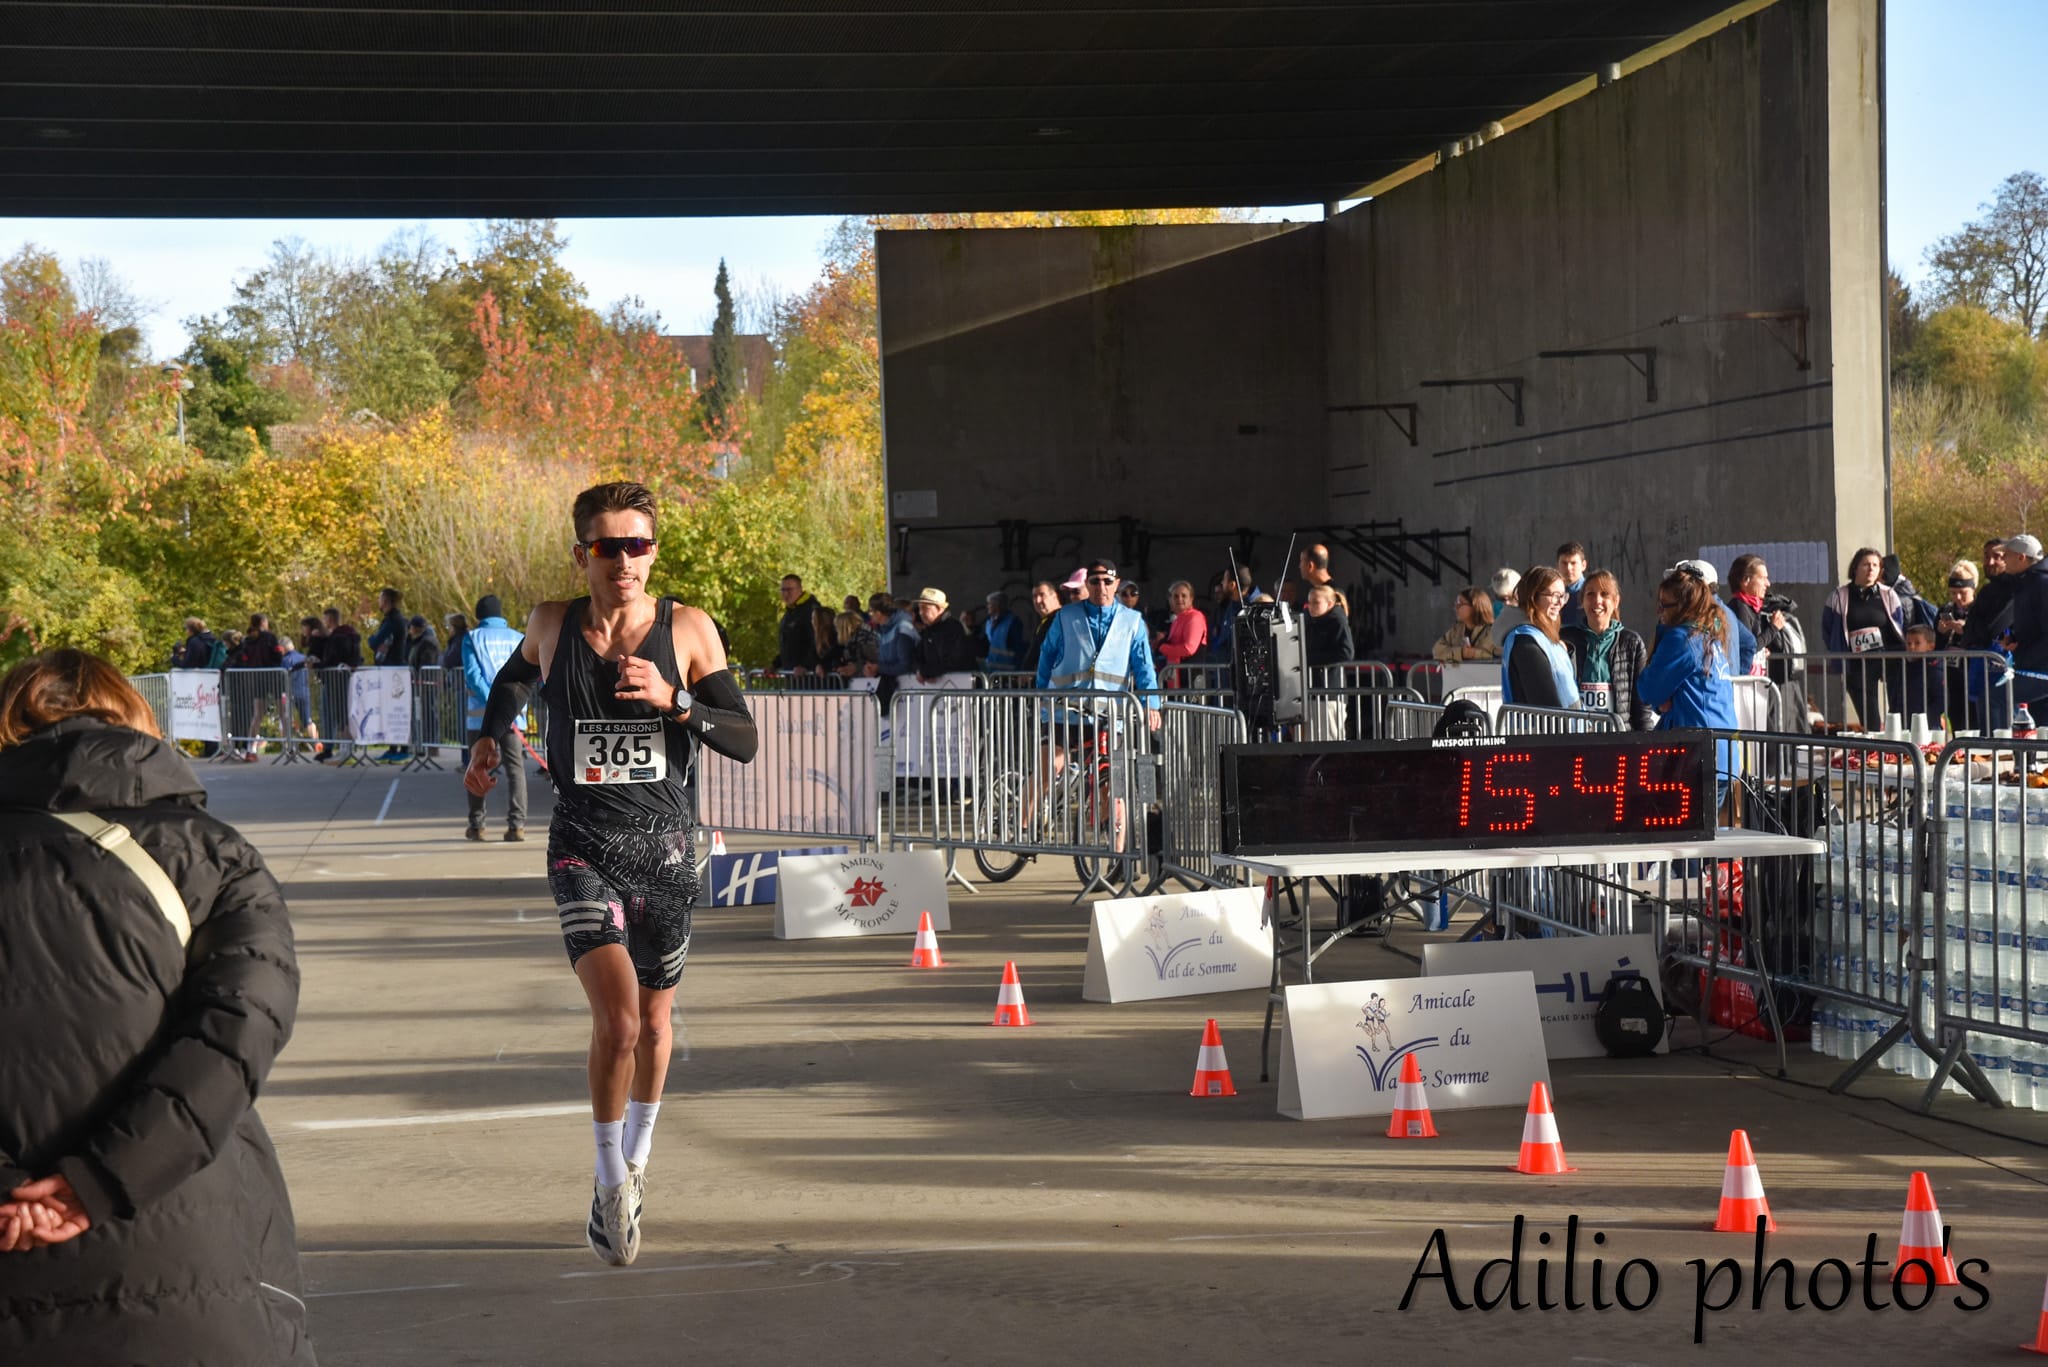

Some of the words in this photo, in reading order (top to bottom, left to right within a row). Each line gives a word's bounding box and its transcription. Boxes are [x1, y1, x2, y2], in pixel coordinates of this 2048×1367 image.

[1855, 632, 1876, 647] 641
[583, 724, 602, 733] LES
[604, 724, 611, 732] 4
[613, 722, 659, 733] SAISONS
[1431, 738, 1474, 748] MATSPORT
[1474, 736, 1506, 746] TIMING
[588, 735, 652, 766] 365
[840, 856, 885, 873] AMIENS
[834, 899, 900, 929] MÉTROPOLE
[1208, 930, 1224, 945] du
[1182, 964, 1195, 977] de
[1197, 961, 1237, 977] Somme
[1407, 988, 1476, 1014] Amicale
[1541, 1014, 1570, 1025] NÇAISE
[1574, 1013, 1596, 1023] D'ATH
[1449, 1027, 1472, 1048] du
[1431, 1068, 1490, 1089] Somme
